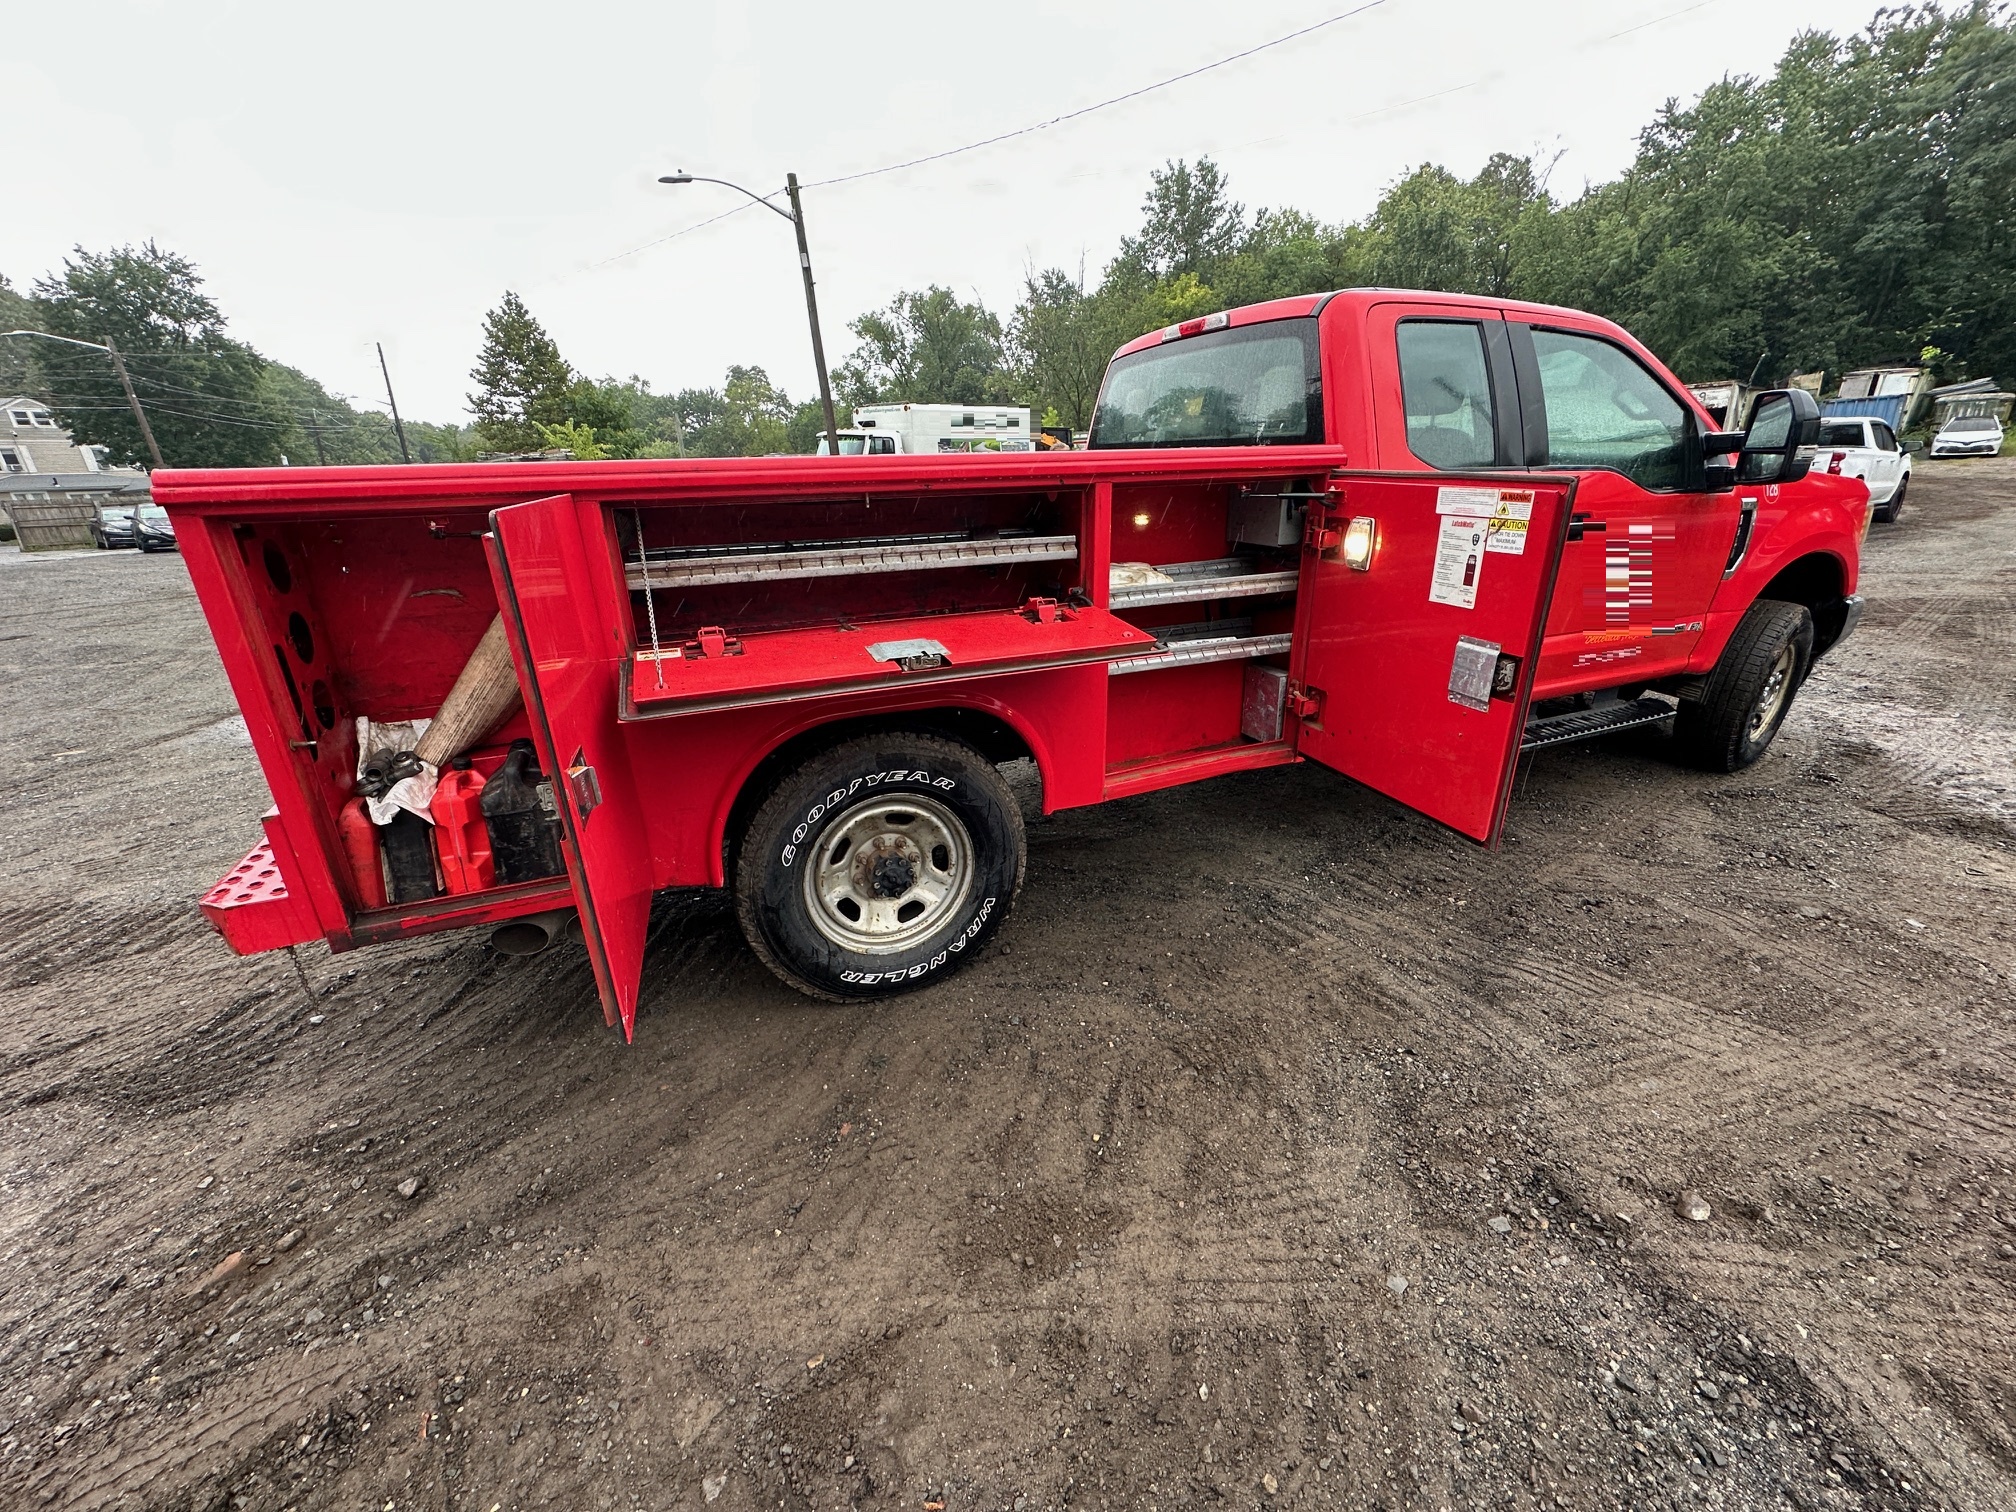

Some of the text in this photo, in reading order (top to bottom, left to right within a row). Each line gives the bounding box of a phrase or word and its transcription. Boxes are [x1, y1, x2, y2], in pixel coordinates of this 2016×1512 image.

[1508, 493, 1531, 502] WARNING
[781, 770, 955, 867] GOODYEAR
[840, 897, 996, 984] WRANGLER
